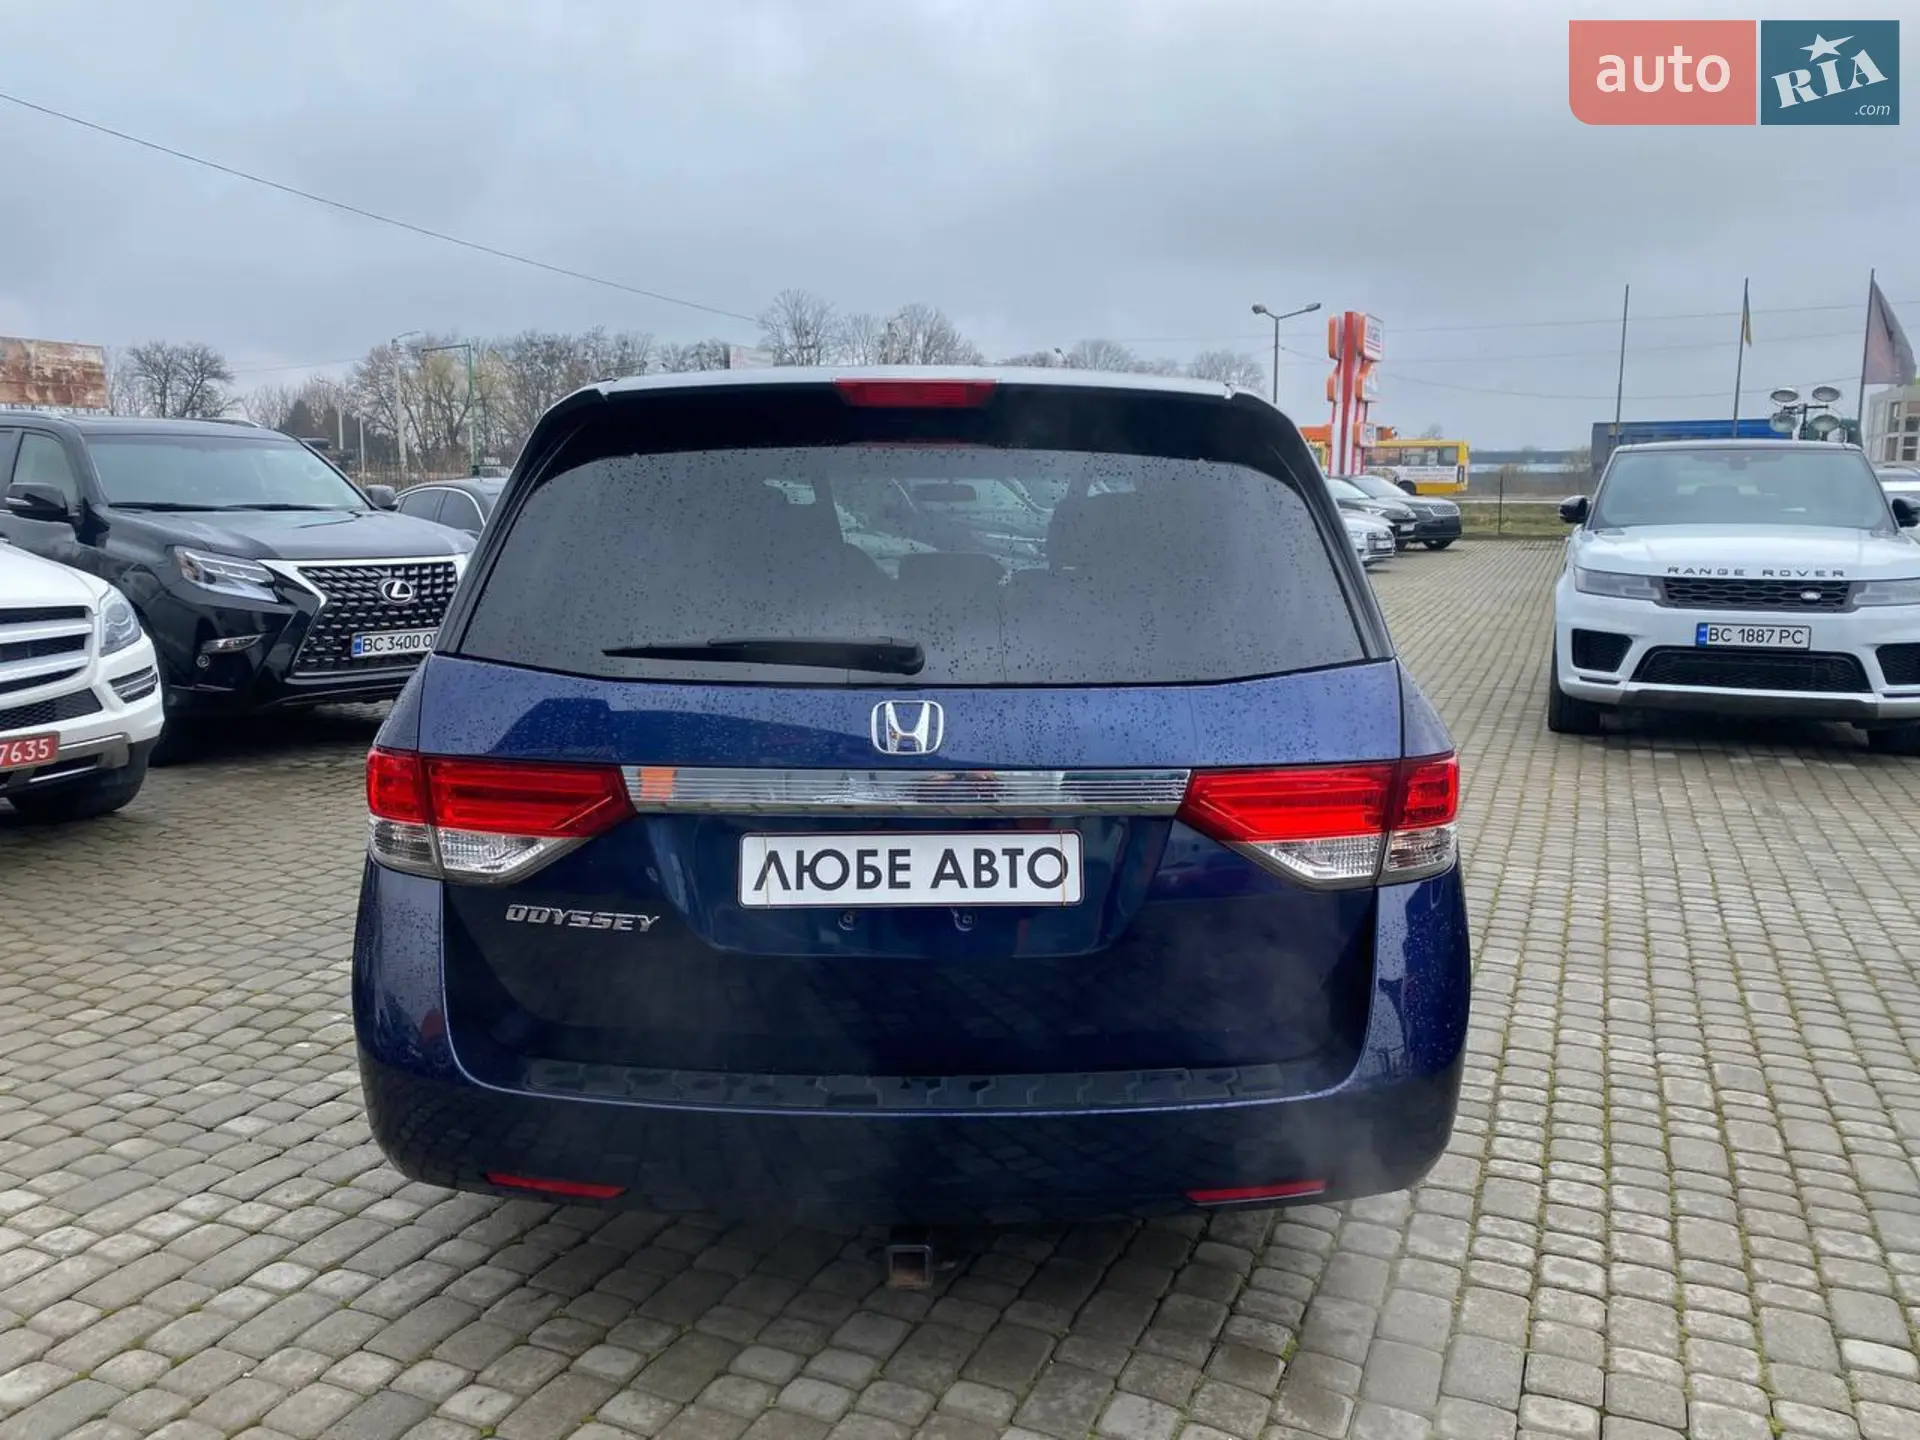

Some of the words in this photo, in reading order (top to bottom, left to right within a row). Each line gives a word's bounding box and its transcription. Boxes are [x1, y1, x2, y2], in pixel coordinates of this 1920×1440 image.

[1667, 567, 1746, 577] RANGE
[1762, 569, 1845, 577] ROVER
[362, 638, 384, 652] BC
[387, 634, 421, 651] 3400
[423, 633, 436, 648] O
[1708, 627, 1733, 643] BC
[1738, 628, 1776, 644] 1887
[1779, 629, 1804, 645] PC
[753, 847, 911, 892] ЛЮБЕ
[930, 846, 1069, 890] АВТО
[505, 903, 661, 932] ODYSSEY
